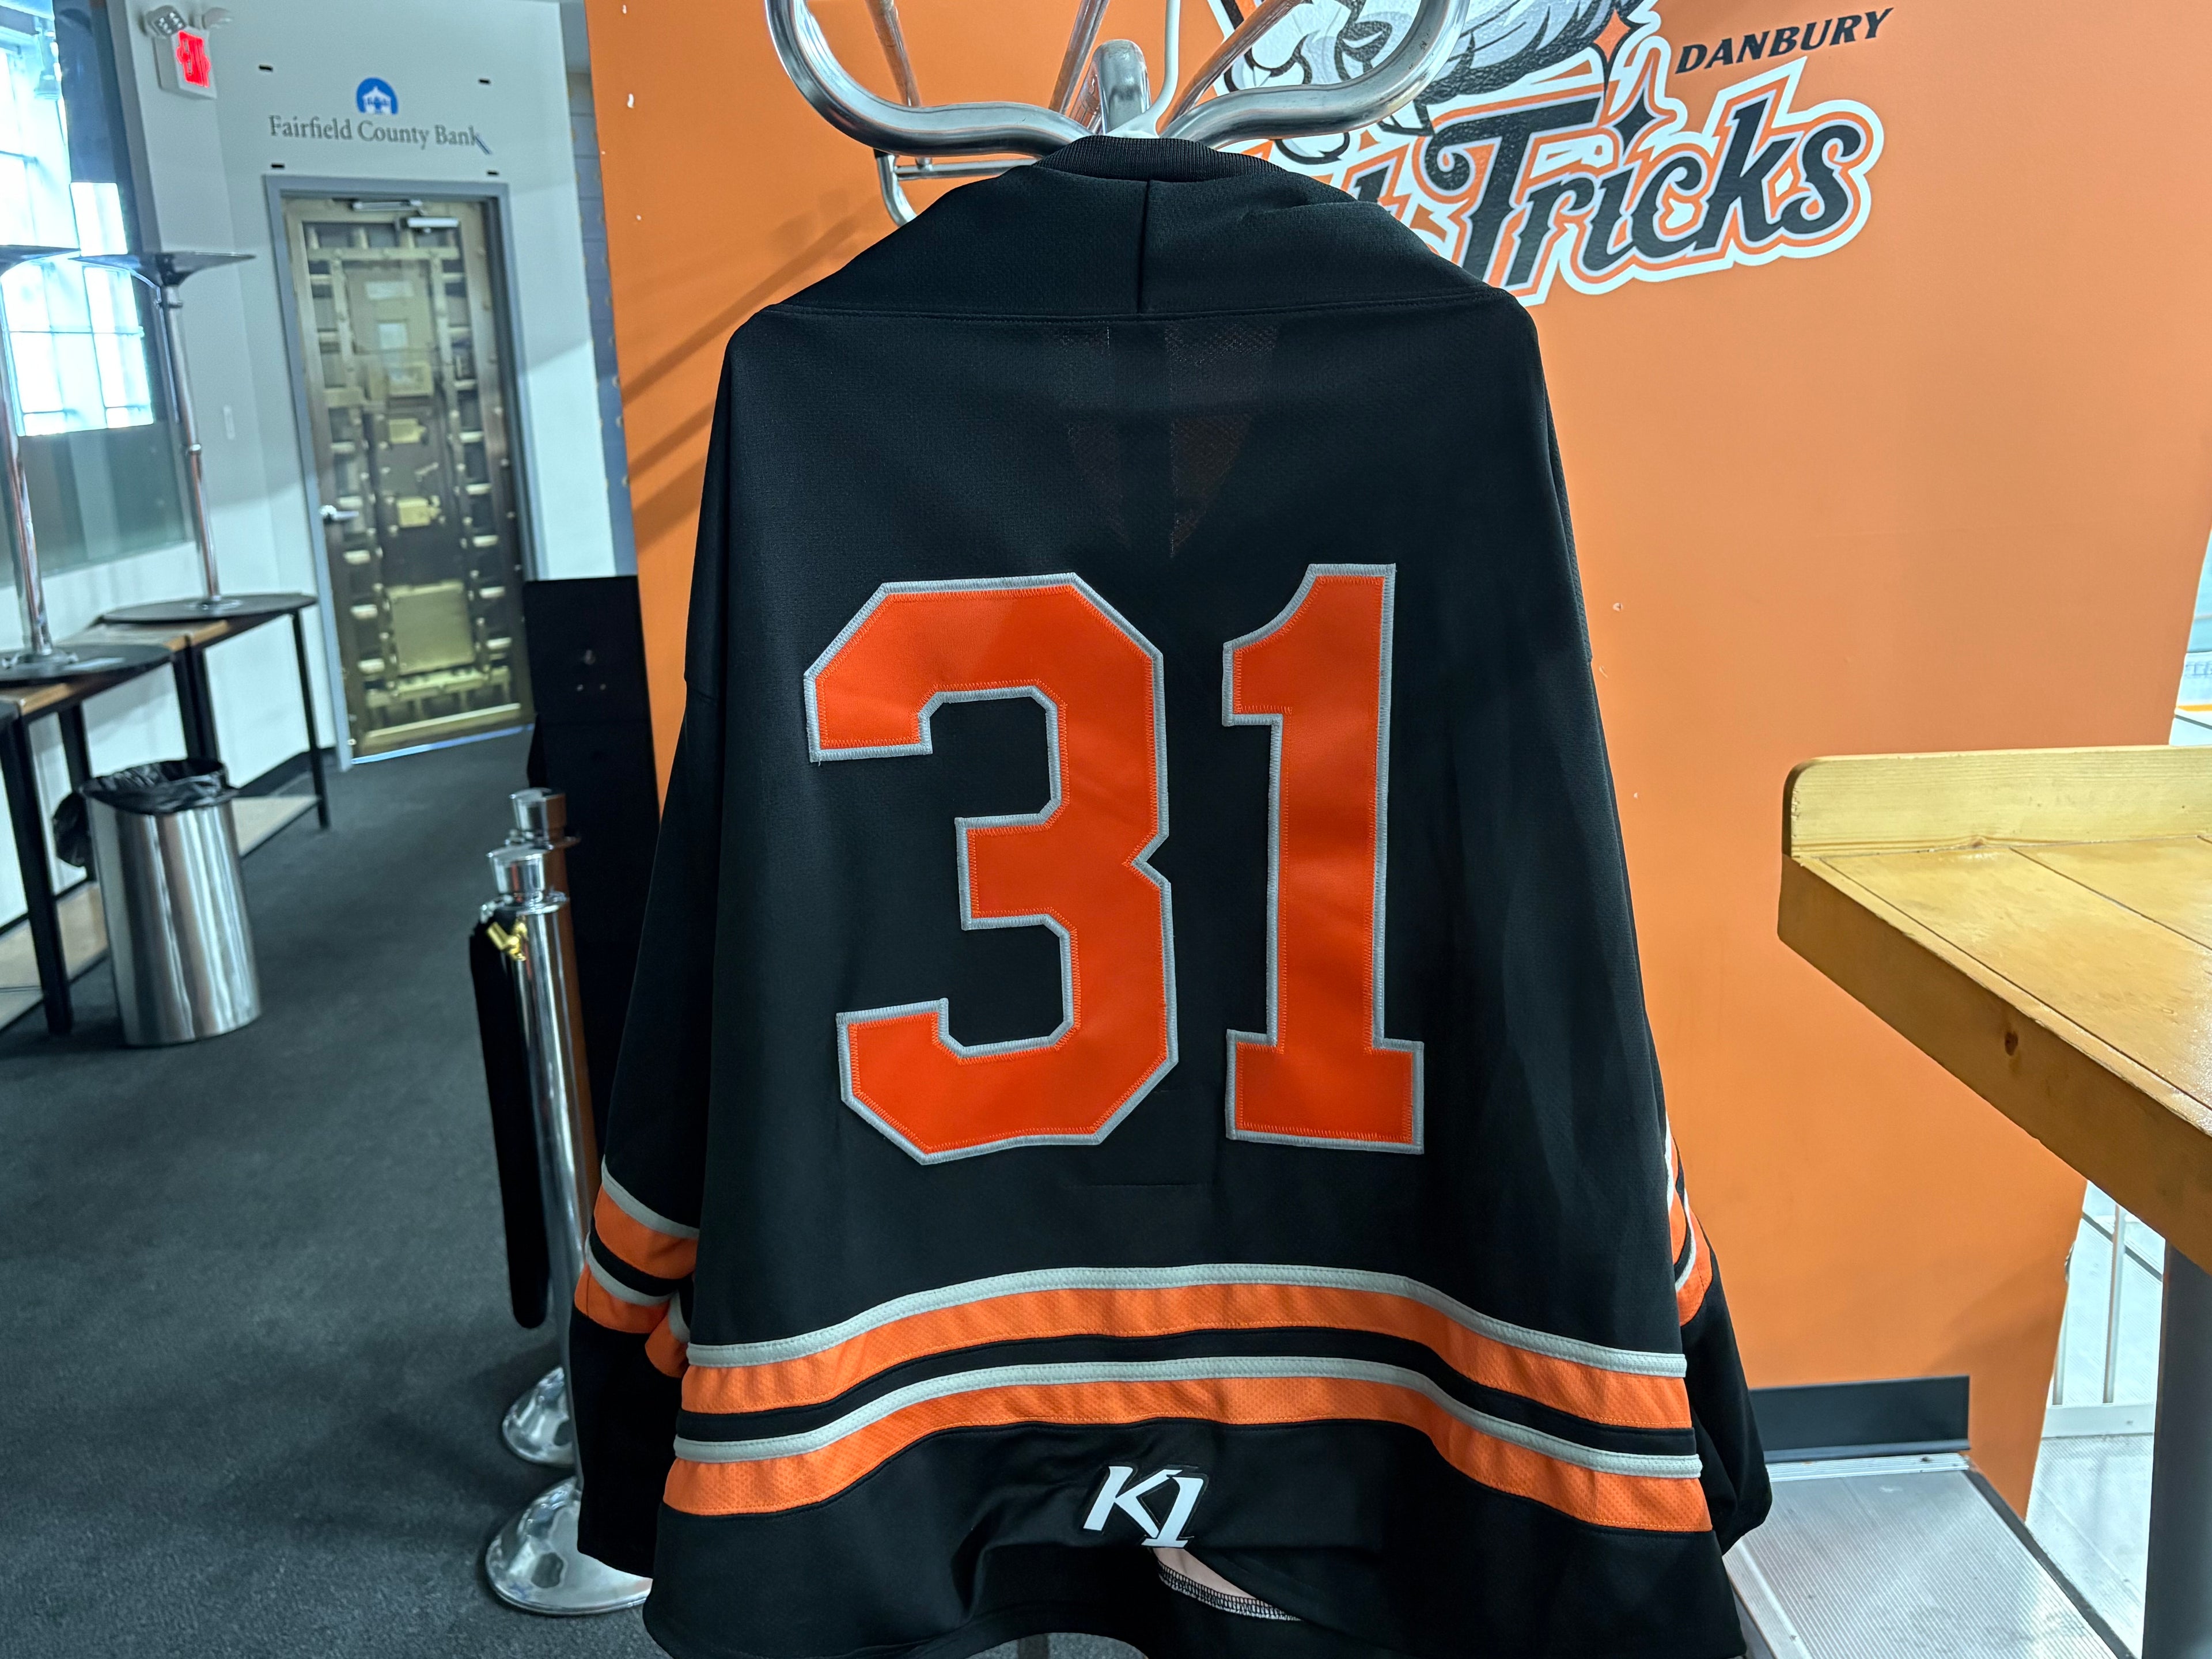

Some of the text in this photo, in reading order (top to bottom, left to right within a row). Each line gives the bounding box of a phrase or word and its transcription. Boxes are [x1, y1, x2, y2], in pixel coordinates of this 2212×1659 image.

[1675, 7, 1894, 74] DANBURY
[268, 115, 489, 153] Fairfield County Bank
[1417, 72, 1870, 291] Tricks
[804, 563, 1424, 1165] 31
[1083, 1465, 1205, 1548] K1
